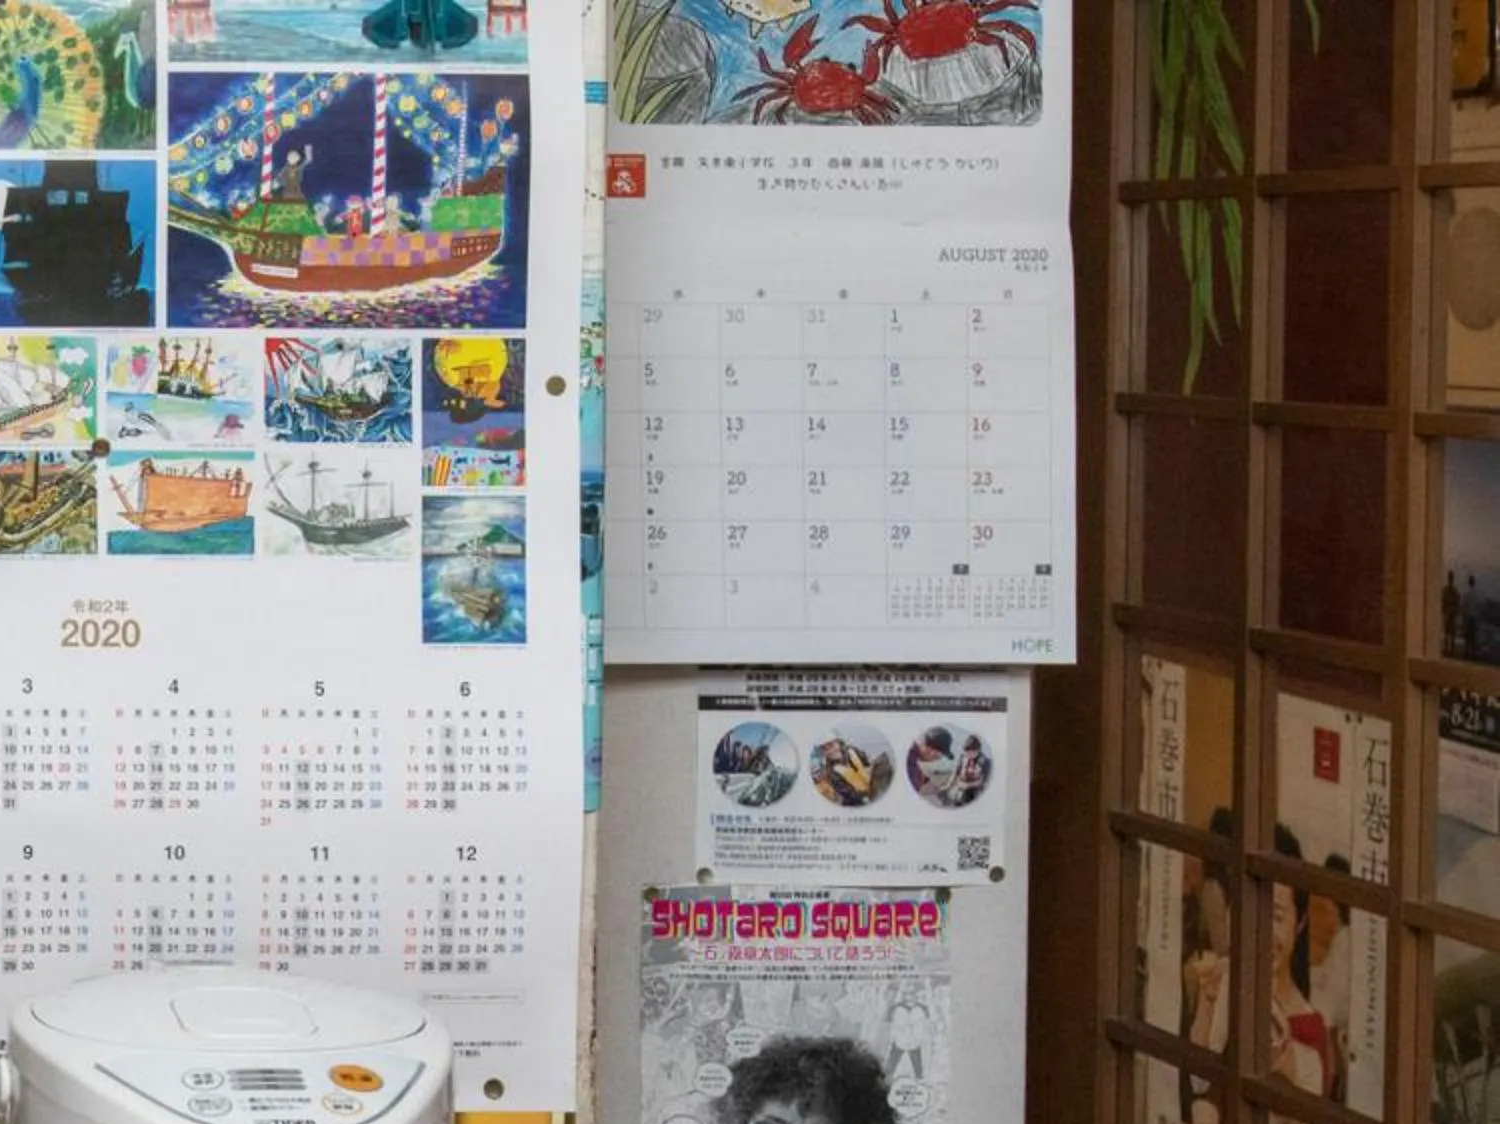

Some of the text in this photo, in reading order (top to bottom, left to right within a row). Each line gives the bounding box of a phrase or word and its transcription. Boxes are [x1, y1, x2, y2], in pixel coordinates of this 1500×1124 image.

[938, 248, 1049, 263] AUGUST 2020
[724, 308, 745, 323] 30
[807, 308, 825, 323] 31
[890, 308, 899, 323] 1
[972, 308, 983, 323] 2
[644, 363, 983, 378] 5 6 7 8 9
[644, 417, 991, 432] 12 13 14 15 16
[645, 471, 993, 486] 19 20 21 22 23
[647, 525, 993, 541] 26 27 28 29 30
[71, 599, 130, 614] 令和2年
[60, 618, 142, 648] 2020
[1011, 639, 1054, 653] HOPE
[21, 678, 34, 695] 3
[167, 678, 180, 695] 4
[314, 681, 326, 697] 5
[459, 681, 472, 697] 6
[22, 845, 34, 861] 9
[163, 845, 186, 861] 10
[310, 846, 330, 861] 11
[455, 846, 478, 862] 12
